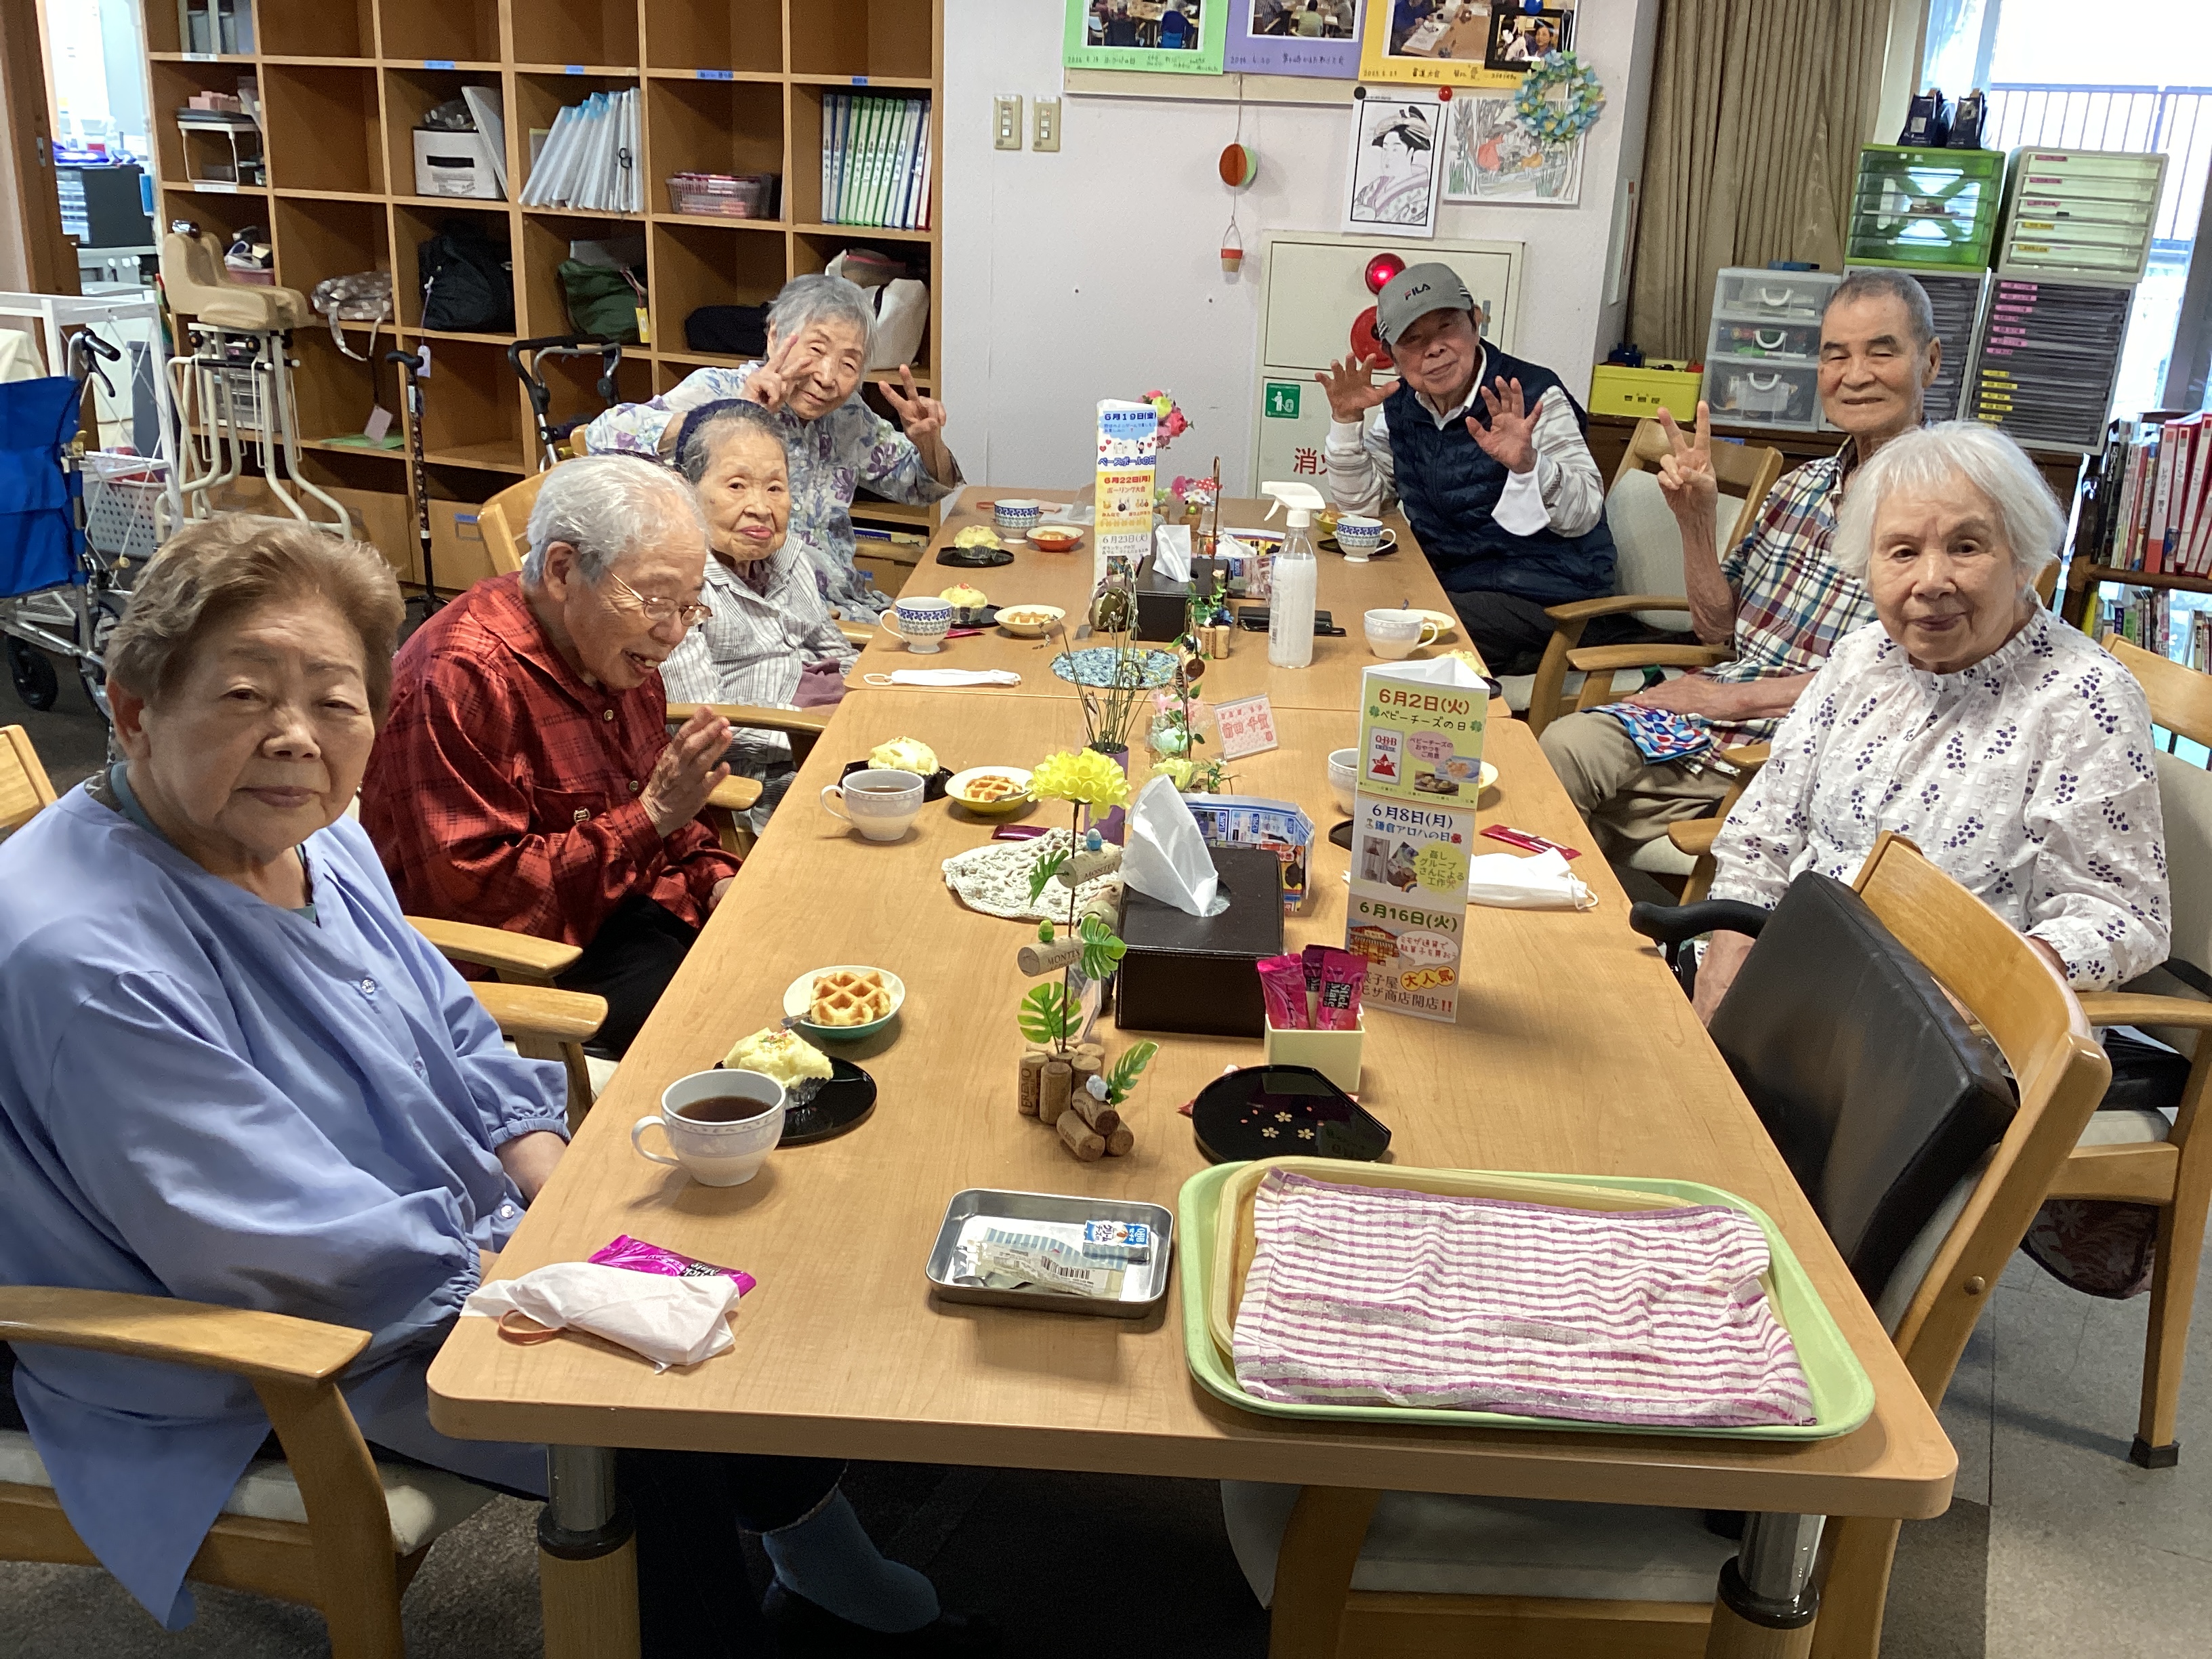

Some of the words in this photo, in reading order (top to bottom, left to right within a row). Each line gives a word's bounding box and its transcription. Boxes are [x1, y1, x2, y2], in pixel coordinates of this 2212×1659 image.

[1404, 283, 1431, 300] FILA
[1098, 455, 1156, 466] ベースボールの日
[1104, 475, 1151, 484] 6月22日(月)
[1103, 533, 1148, 544] 6月23日(火)
[1378, 689, 1469, 714] 6月2日(火)
[1380, 711, 1467, 731] ベビーチーズの日
[1223, 722, 1244, 739] 前田
[1410, 737, 1453, 748] ベビーチーズの
[1415, 744, 1439, 753] おやつを
[1372, 804, 1452, 830] 6月8日(月)
[1084, 862, 1115, 880] MONTES
[1420, 858, 1457, 869] グループ
[1419, 867, 1464, 880] さんによる
[1427, 876, 1446, 887] 工作
[1359, 901, 1457, 932] 6月16日(火)
[1047, 947, 1080, 965] MONTES
[1404, 968, 1454, 987] 大人気
[1328, 983, 1338, 1008] Mate
[1339, 983, 1351, 1008] Stick
[1101, 1224, 1112, 1242] クリーム
[1135, 1227, 1146, 1243] QBB
